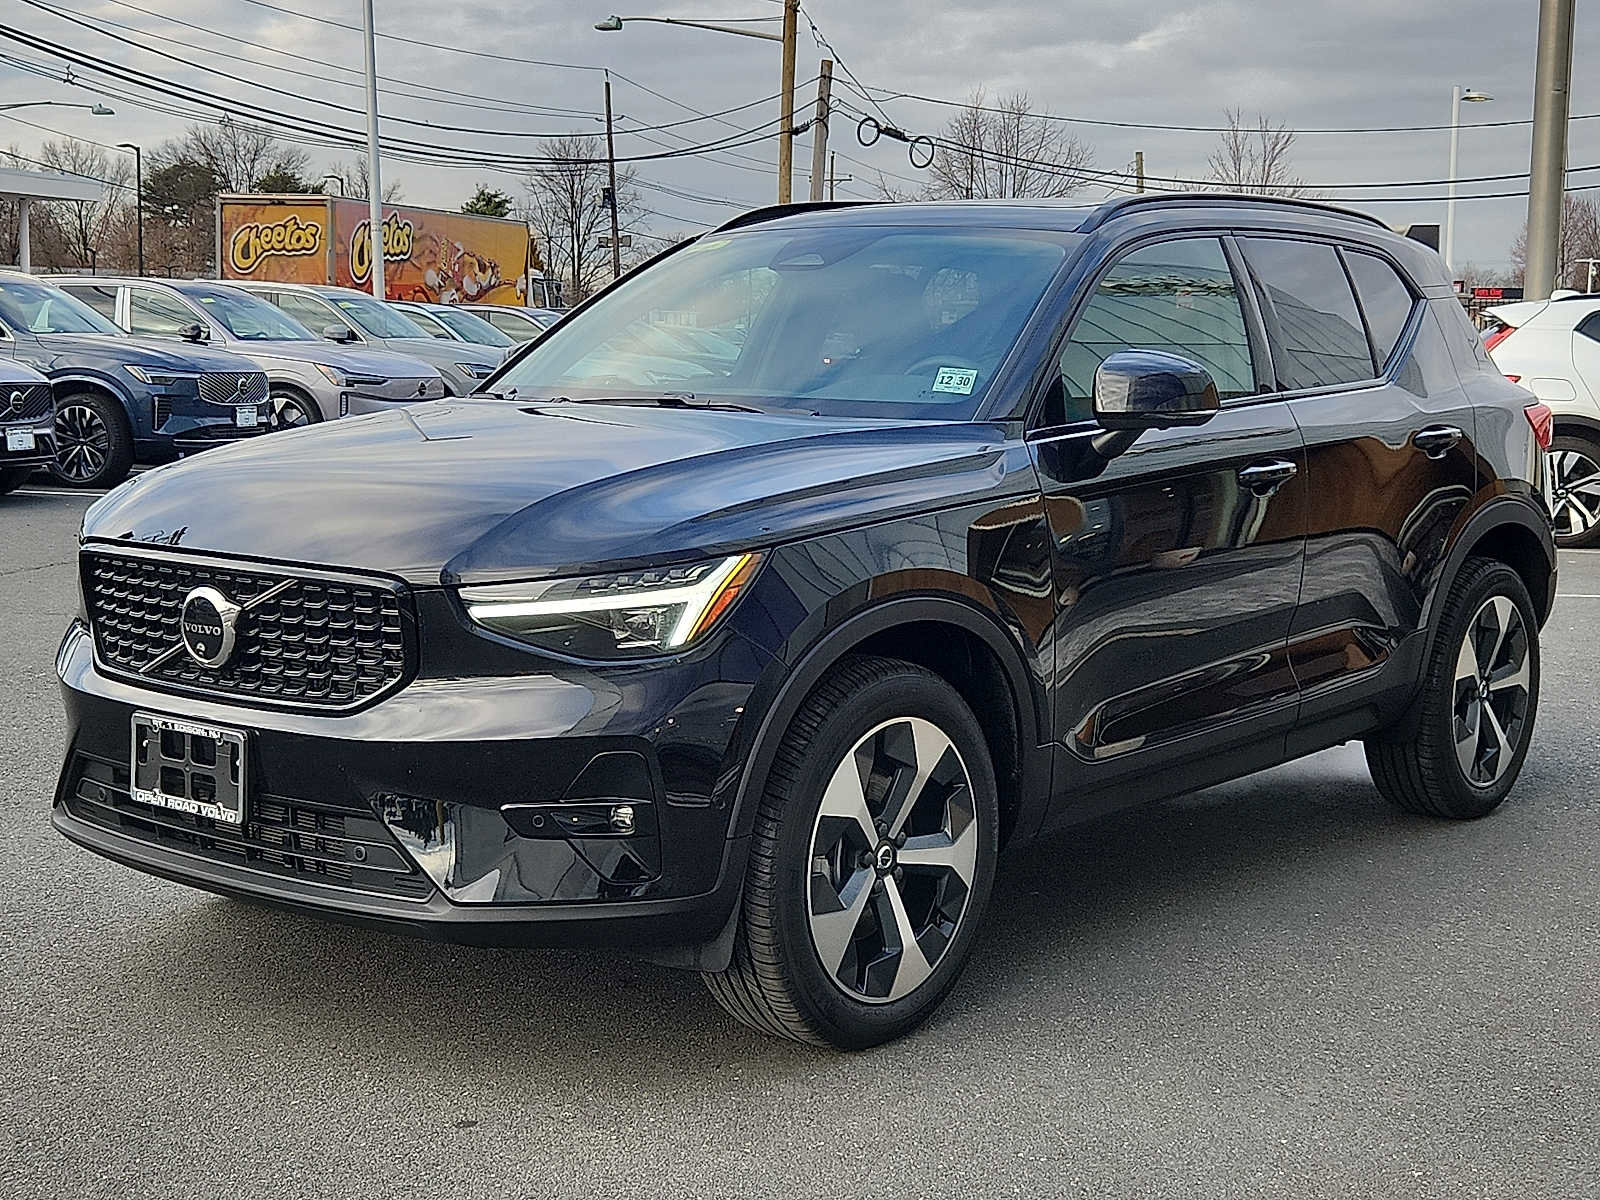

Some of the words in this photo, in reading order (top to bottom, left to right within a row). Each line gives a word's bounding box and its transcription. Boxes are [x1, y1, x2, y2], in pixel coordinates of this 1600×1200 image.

[232, 216, 319, 270] Cheetos
[351, 213, 412, 280] Chetos
[939, 375, 954, 385] 12
[956, 376, 971, 387] 30
[184, 622, 221, 636] VOLVO
[136, 791, 166, 807] OPEN
[167, 798, 199, 813] ROAD
[200, 805, 236, 823] VOLVO
